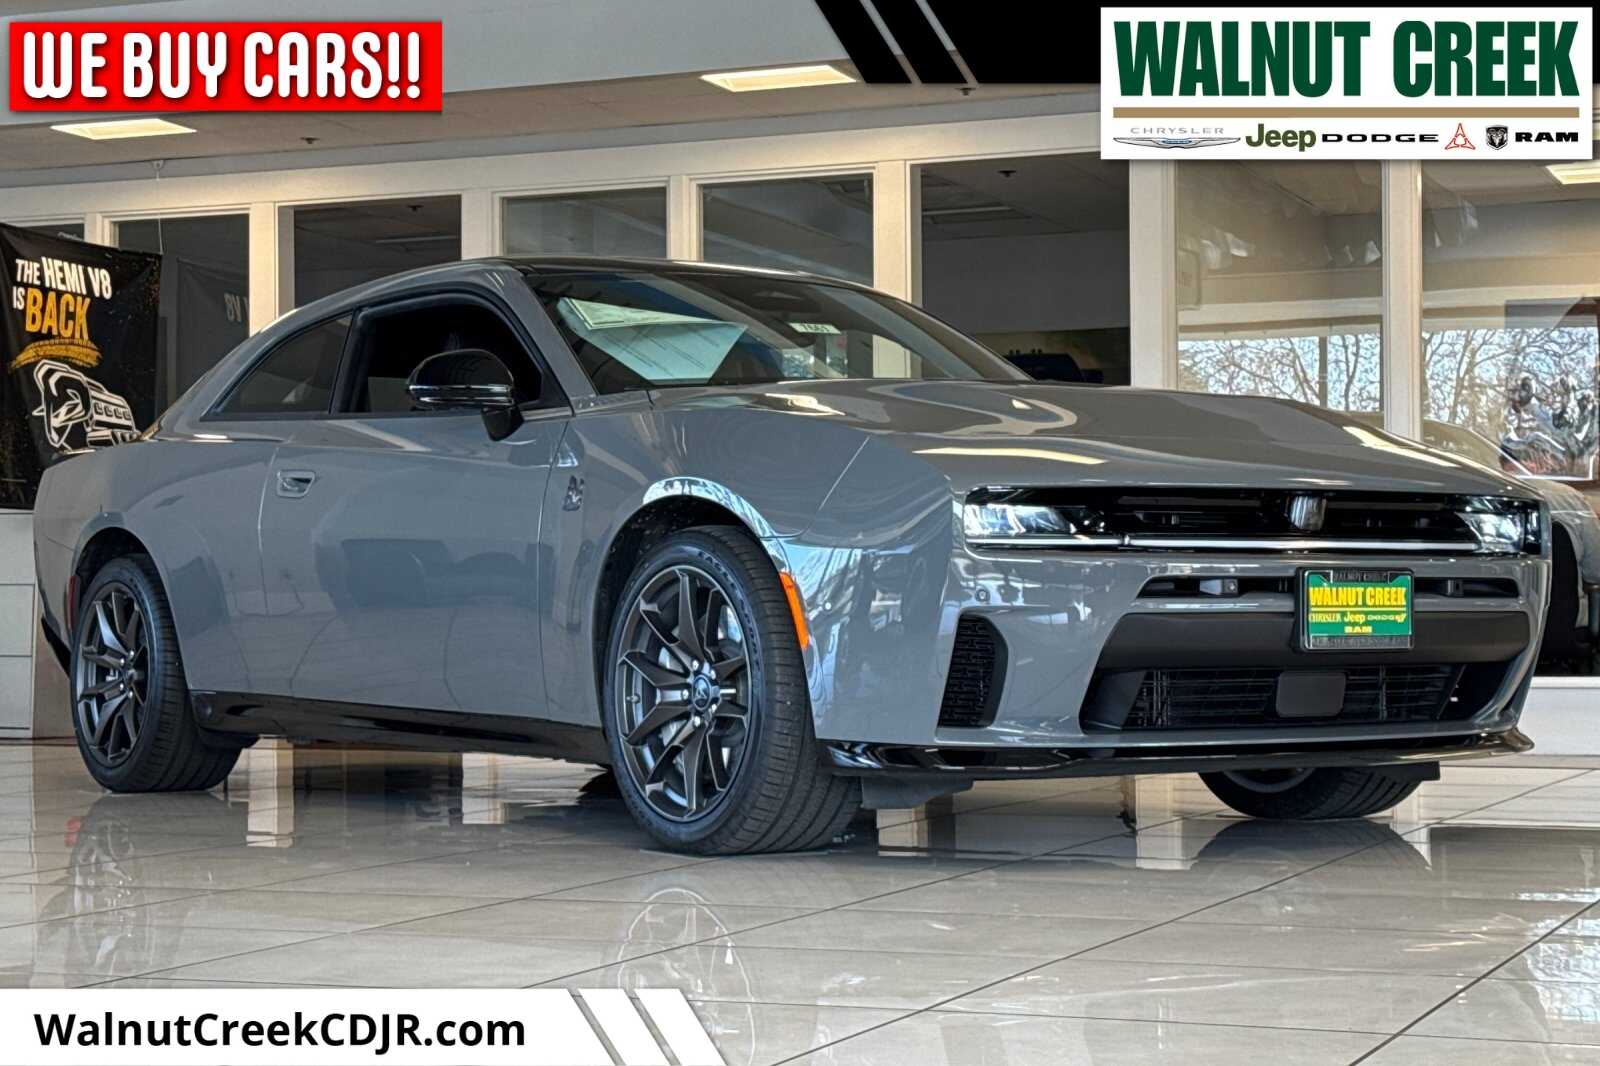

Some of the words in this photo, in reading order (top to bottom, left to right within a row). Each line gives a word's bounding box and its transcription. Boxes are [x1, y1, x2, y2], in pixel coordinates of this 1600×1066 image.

[16, 258, 41, 285] THE
[41, 256, 87, 295] HEMI
[87, 266, 112, 300] V8
[13, 286, 25, 310] IS
[25, 287, 91, 341] BACK
[1309, 587, 1364, 606] WALNUT
[1365, 587, 1406, 606] CREEK
[1344, 611, 1366, 624] Jeep
